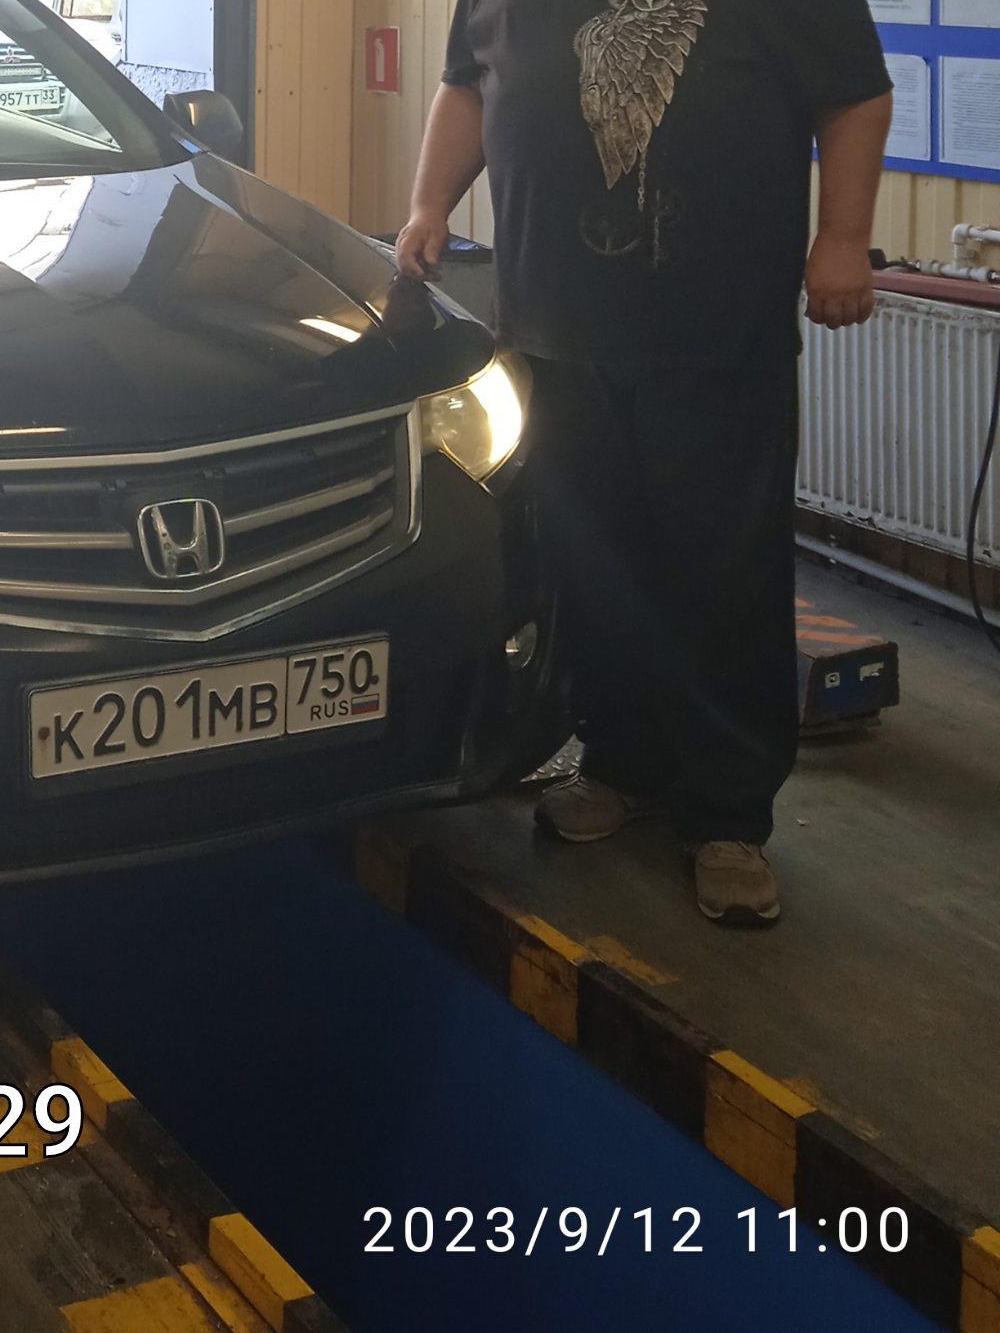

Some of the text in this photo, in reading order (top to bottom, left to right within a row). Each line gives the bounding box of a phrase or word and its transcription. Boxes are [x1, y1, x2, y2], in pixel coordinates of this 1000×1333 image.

[53, 650, 374, 764] К201МВ 750
[311, 699, 349, 722] RUS
